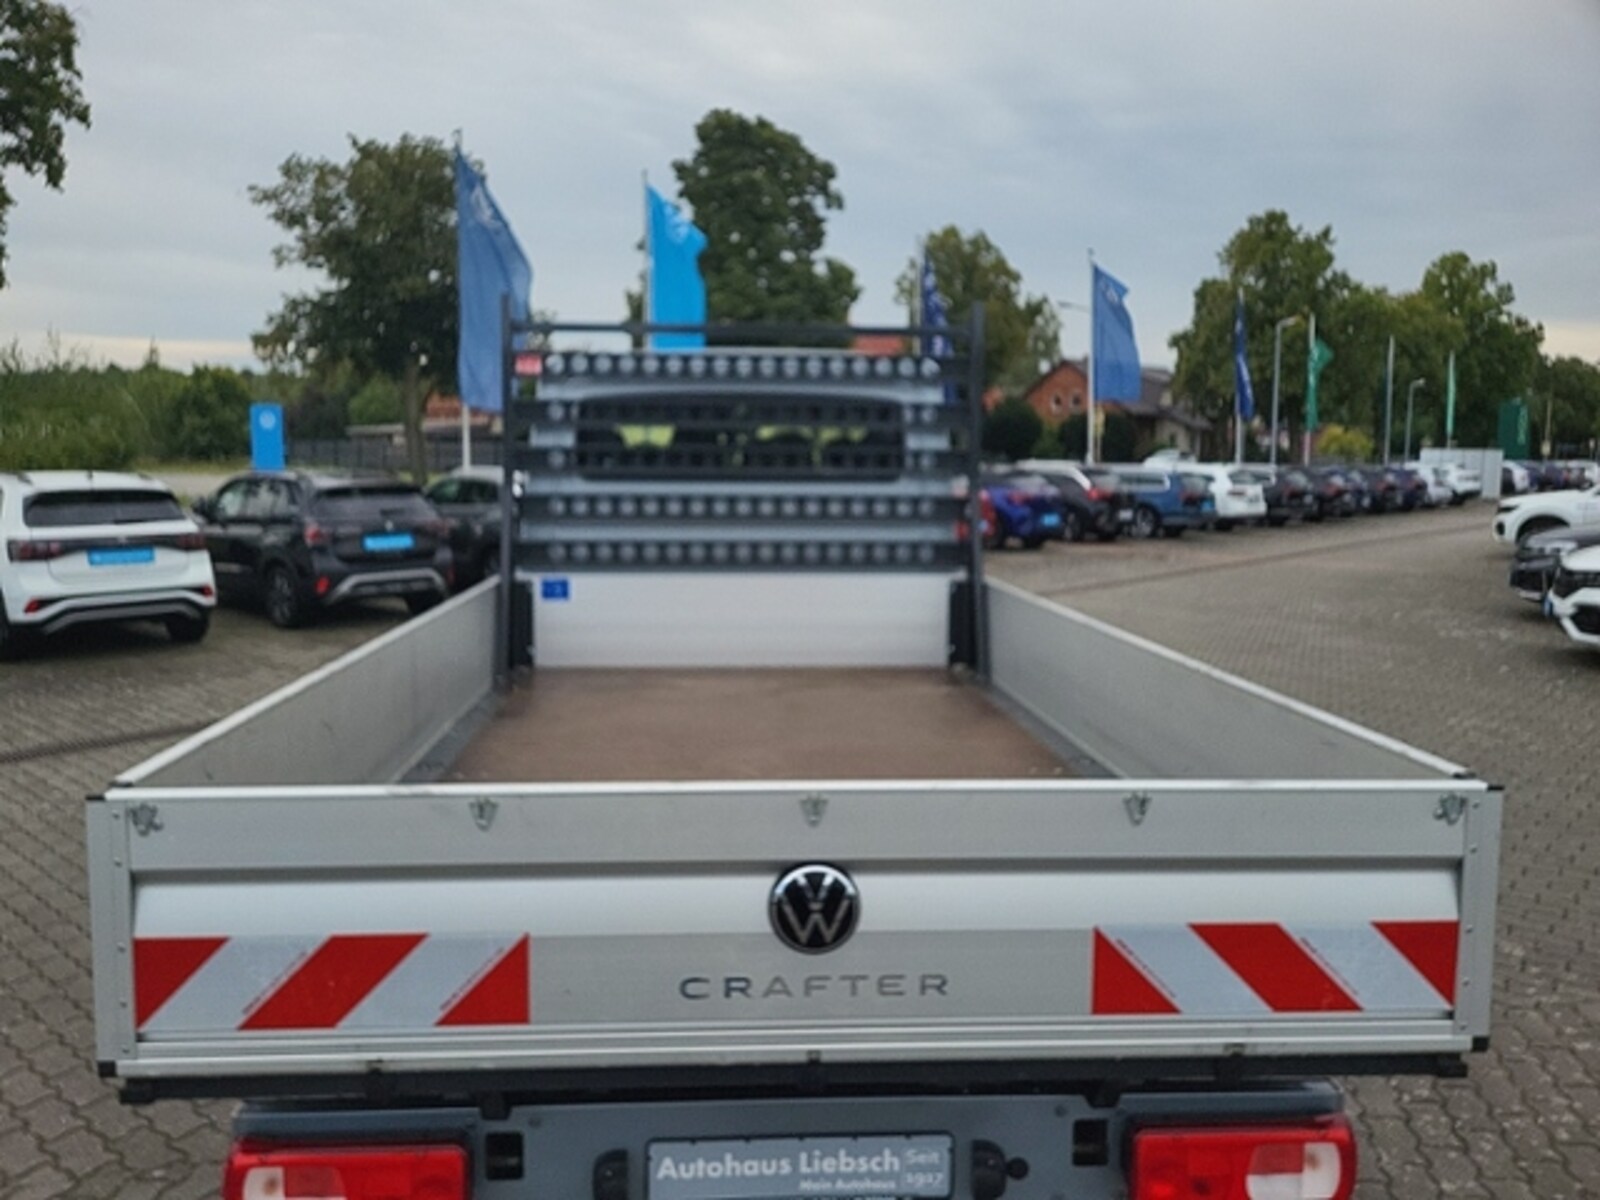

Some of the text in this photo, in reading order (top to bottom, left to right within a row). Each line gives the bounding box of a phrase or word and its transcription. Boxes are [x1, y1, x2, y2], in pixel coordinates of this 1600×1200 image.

[679, 974, 949, 1000] CRAFTER
[656, 1148, 900, 1180] Autohaus Liebsch
